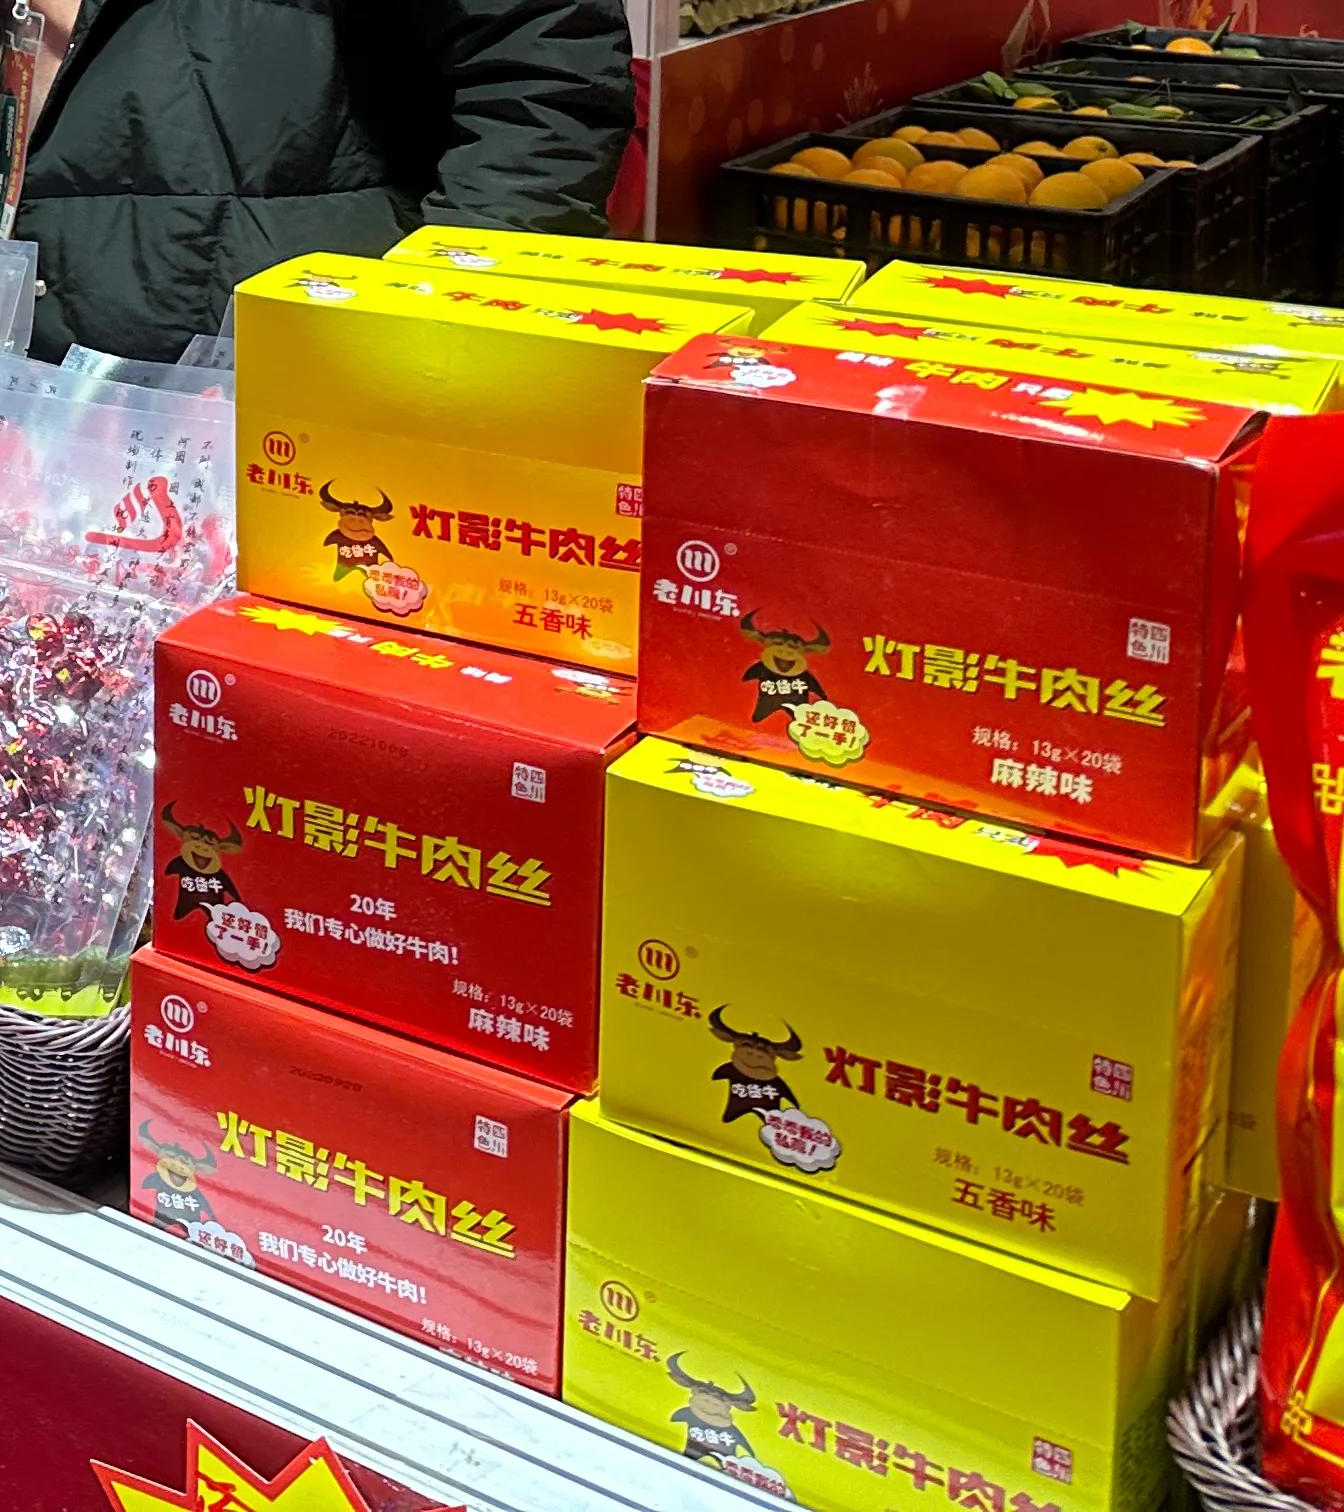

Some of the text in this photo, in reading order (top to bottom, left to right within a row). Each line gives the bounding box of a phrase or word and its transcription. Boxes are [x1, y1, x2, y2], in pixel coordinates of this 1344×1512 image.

[904, 360, 1011, 391] 牛肉
[245, 462, 315, 496] 老川东
[409, 504, 643, 573] 灯影牛肉丝
[653, 577, 740, 617] 老川东
[512, 603, 593, 640] 五香味
[759, 677, 809, 696] 吃货牛
[862, 633, 1169, 729] 灯影牛肉丝
[168, 702, 239, 742] 老川东
[989, 756, 1095, 804] 麻辣味
[242, 784, 554, 909] 灯影牛肉丝
[180, 875, 224, 896] 吃货牛
[349, 893, 398, 922] 20年
[615, 971, 704, 1021] 老川东
[144, 1022, 213, 1069] 老川东
[467, 1007, 552, 1054] 麻辣味
[730, 1081, 781, 1102] 吃货牛
[822, 1044, 1133, 1167] 灯影牛肉丝
[157, 1190, 201, 1214] 吃货牛
[215, 1110, 517, 1261] 灯影牛肉丝
[950, 1177, 1058, 1236] 五香味
[321, 1223, 369, 1256] 20年
[578, 1308, 661, 1362] 老川东
[688, 1426, 736, 1449] 吃货牛
